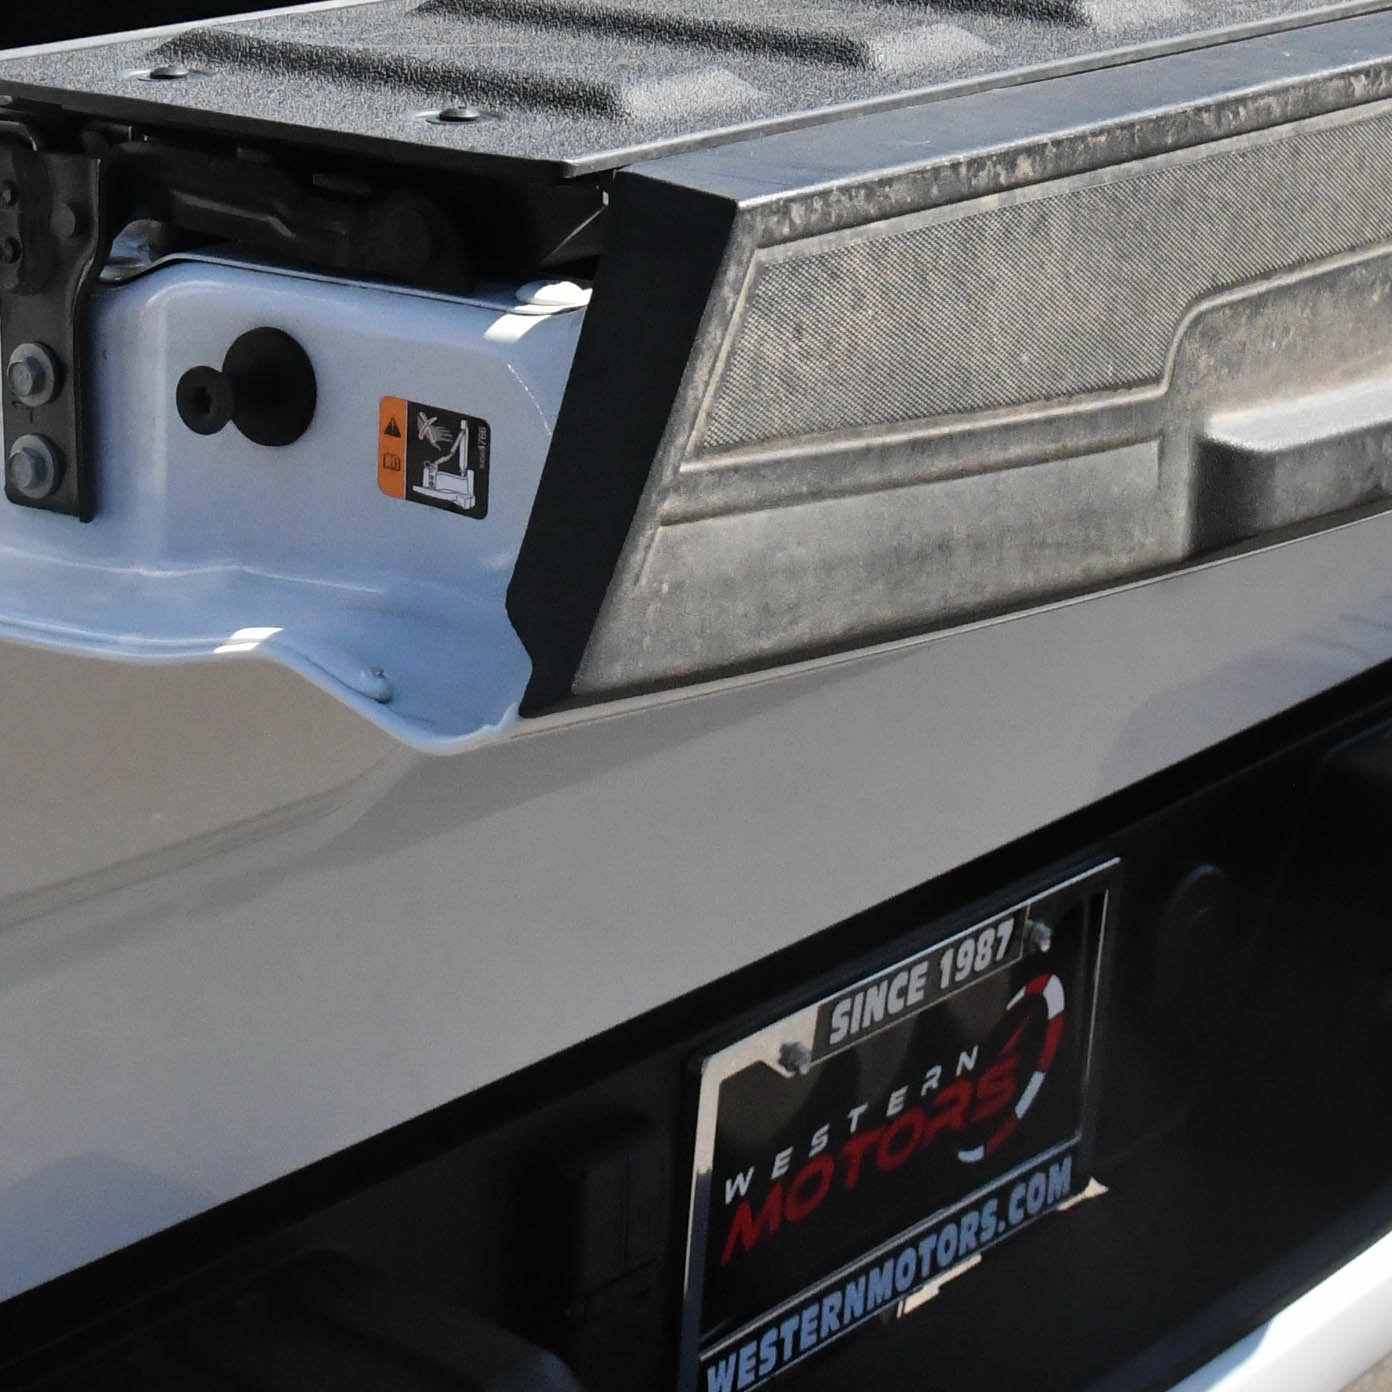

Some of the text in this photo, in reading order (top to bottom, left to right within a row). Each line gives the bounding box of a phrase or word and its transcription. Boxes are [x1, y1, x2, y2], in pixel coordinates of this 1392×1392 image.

[829, 918, 1014, 1045] SINCE 1987
[720, 1058, 1021, 1267] MOTORS
[725, 1045, 979, 1205] WESTERN
[707, 1156, 1072, 1392] WESTERNMOTORS.COM
